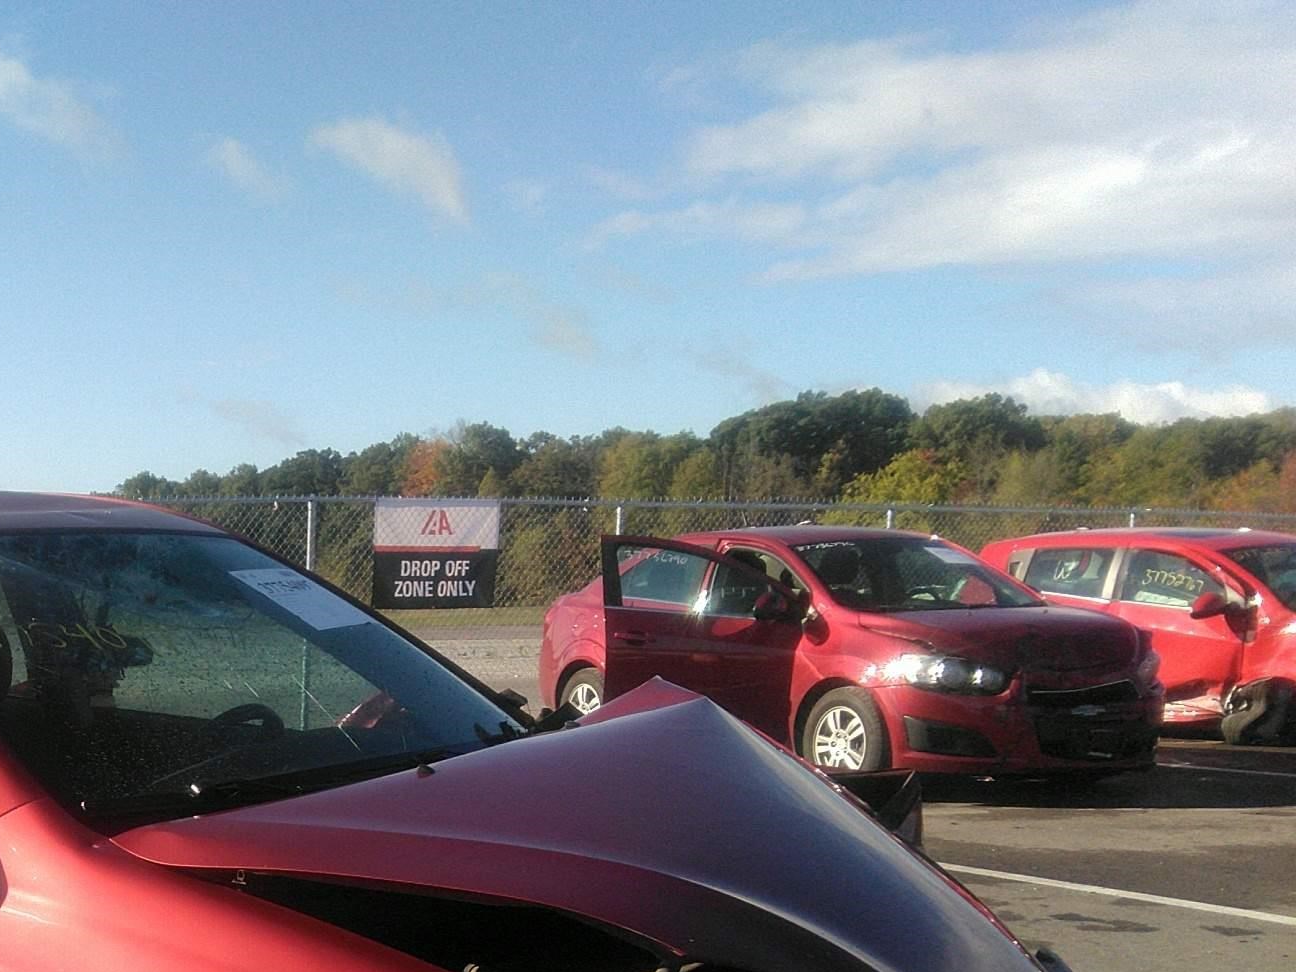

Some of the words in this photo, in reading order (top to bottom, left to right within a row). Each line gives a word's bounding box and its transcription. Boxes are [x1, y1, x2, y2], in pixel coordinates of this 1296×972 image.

[400, 560, 440, 577] DROP
[445, 560, 470, 577] OFF
[394, 581, 433, 597] ZONE
[437, 580, 476, 597] ONLY
